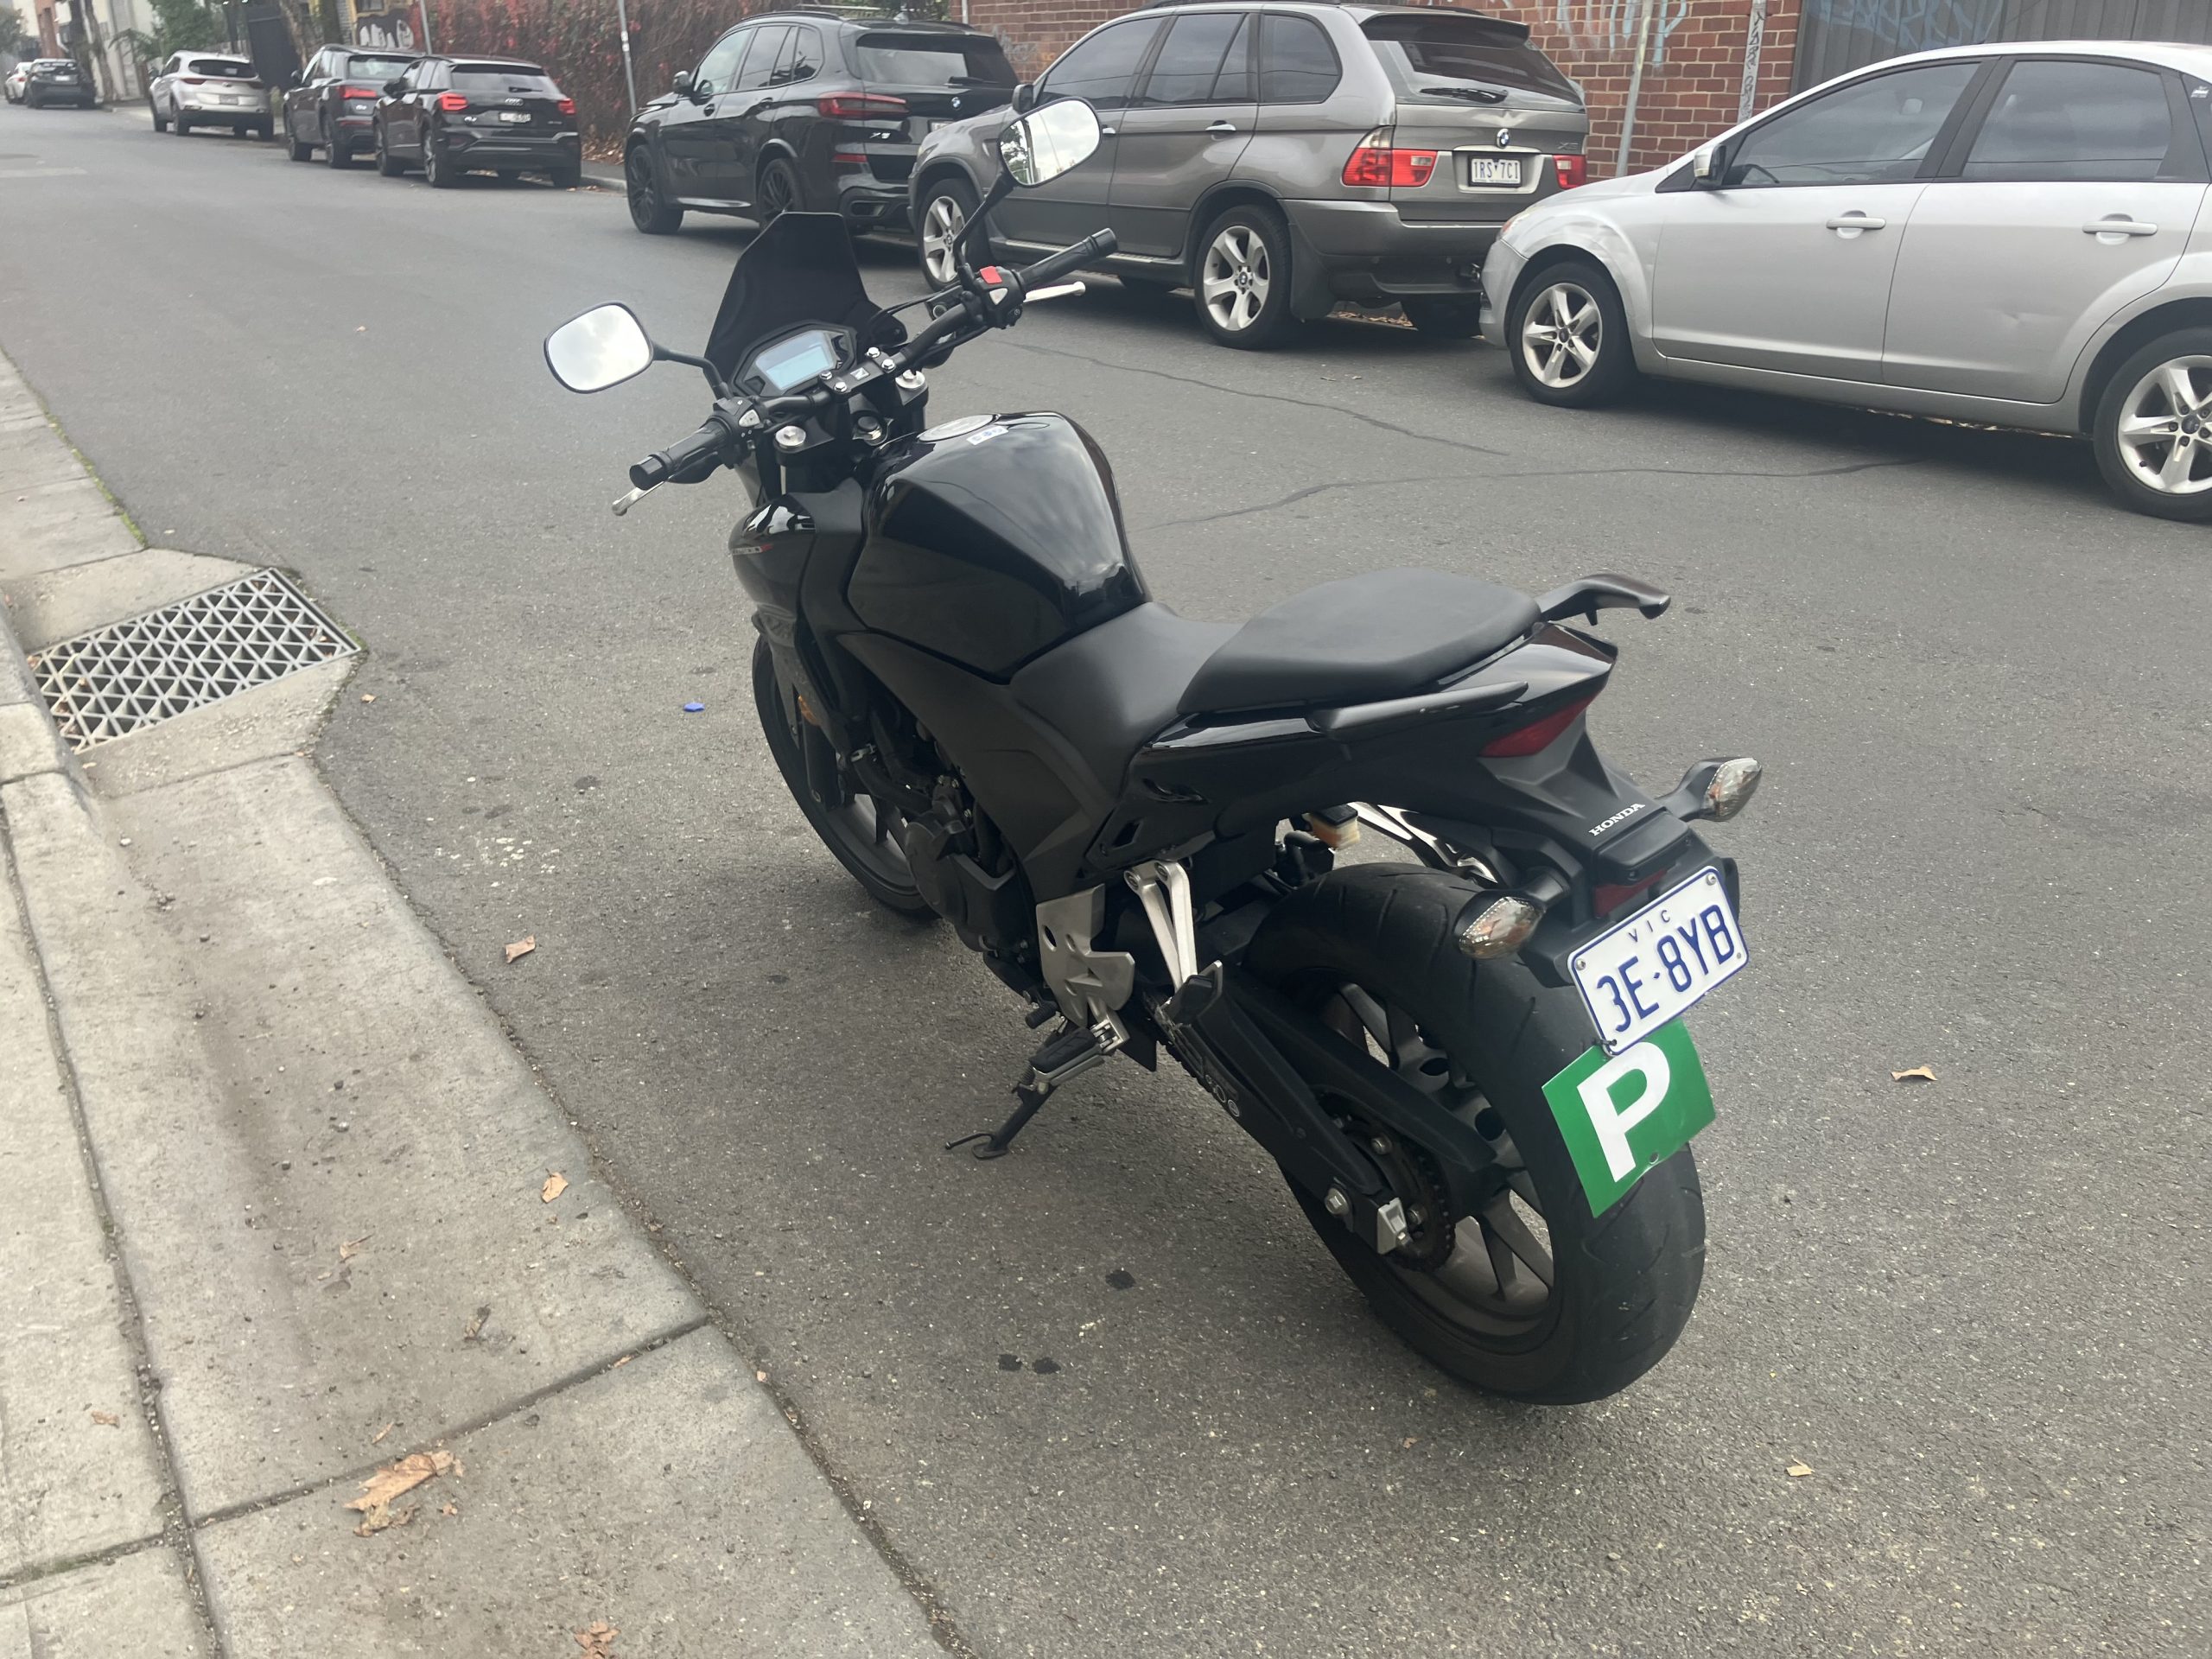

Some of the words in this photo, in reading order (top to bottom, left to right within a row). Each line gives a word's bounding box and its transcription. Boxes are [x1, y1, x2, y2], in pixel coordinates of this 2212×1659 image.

[1588, 804, 1646, 836] HONDA
[1628, 910, 1671, 943] VIC
[1577, 1041, 1670, 1183] P
